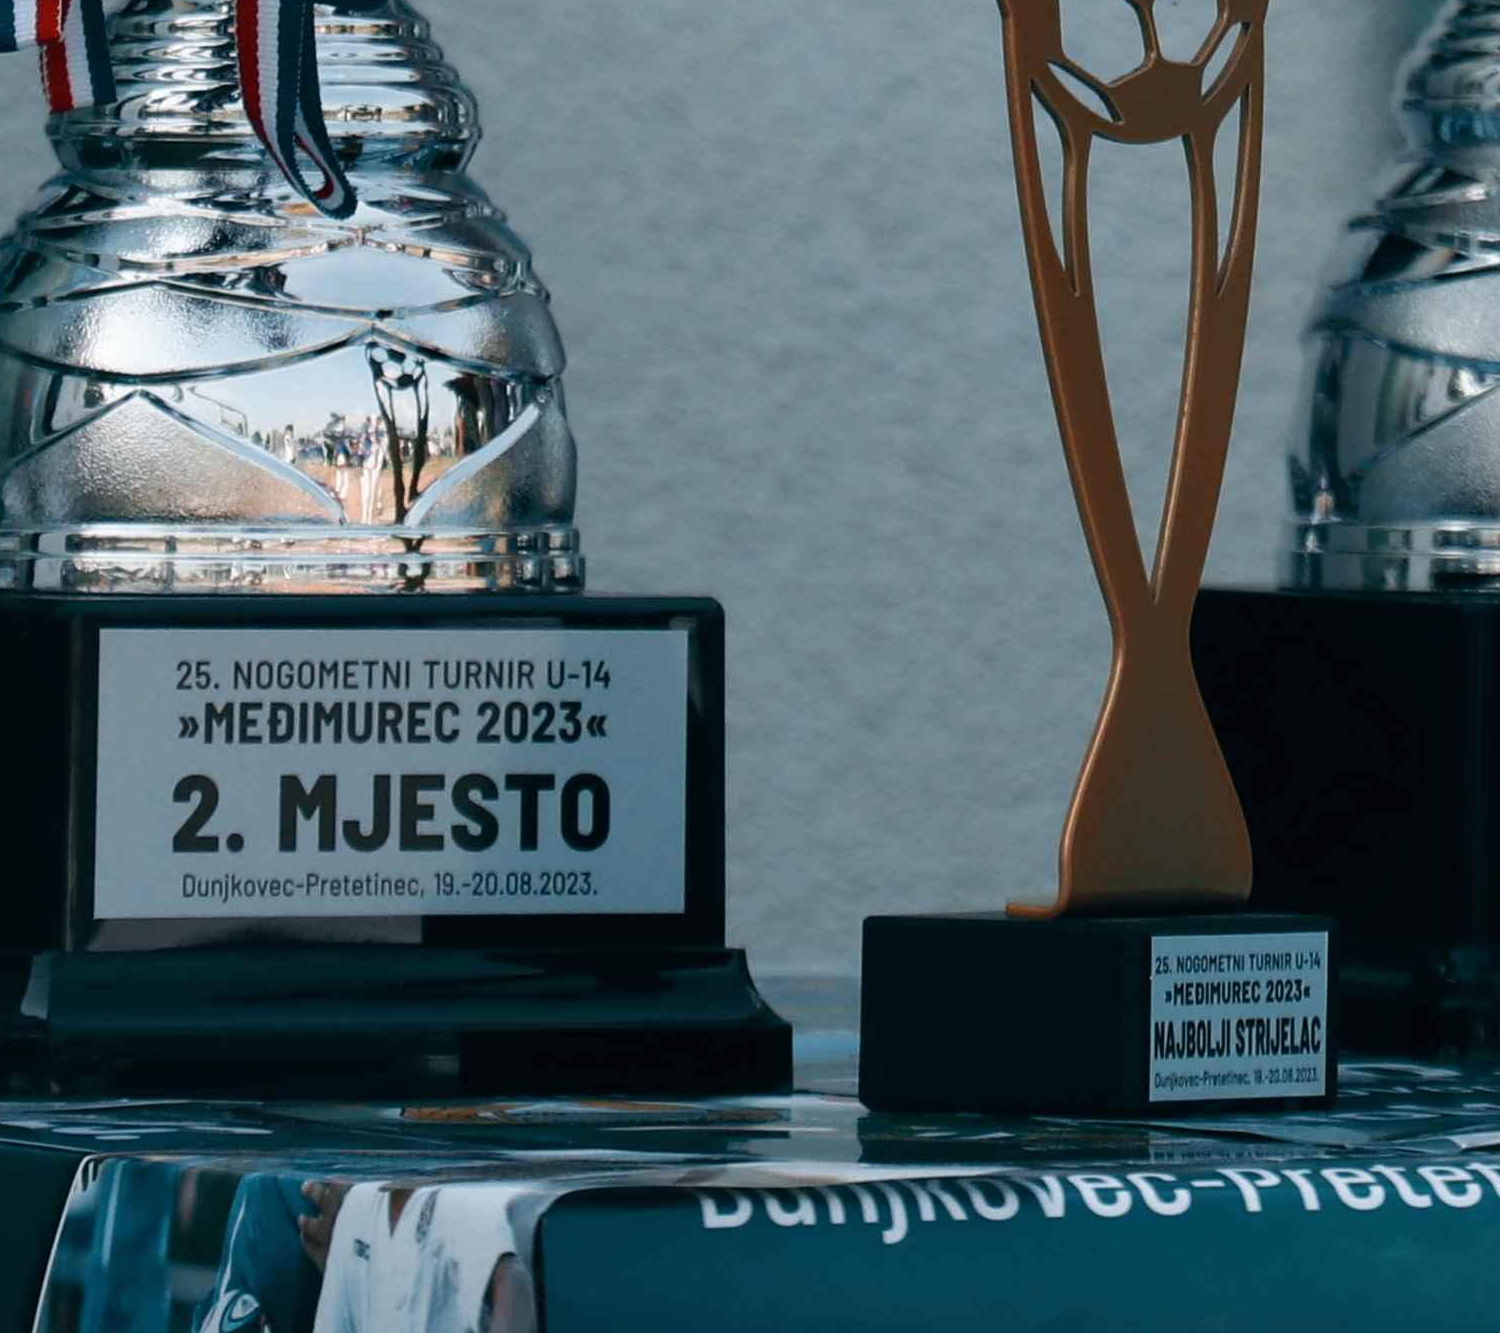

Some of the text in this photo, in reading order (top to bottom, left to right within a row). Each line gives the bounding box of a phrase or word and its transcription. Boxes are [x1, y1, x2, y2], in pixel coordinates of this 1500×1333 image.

[175, 660, 611, 690] 25. NOGOMETNI TURNIR U-14
[177, 700, 607, 745] »MEĐIMUREC 2023«
[171, 773, 612, 854] 2. MJESTO
[182, 873, 599, 903] Dunjkovec-Pretetinec, 19.-20.08.2023.
[1155, 949, 1321, 975] 25. NOGOMETNI TURNIR U-14
[1154, 1016, 1321, 1060] NAJBOLJI STRIJELAC
